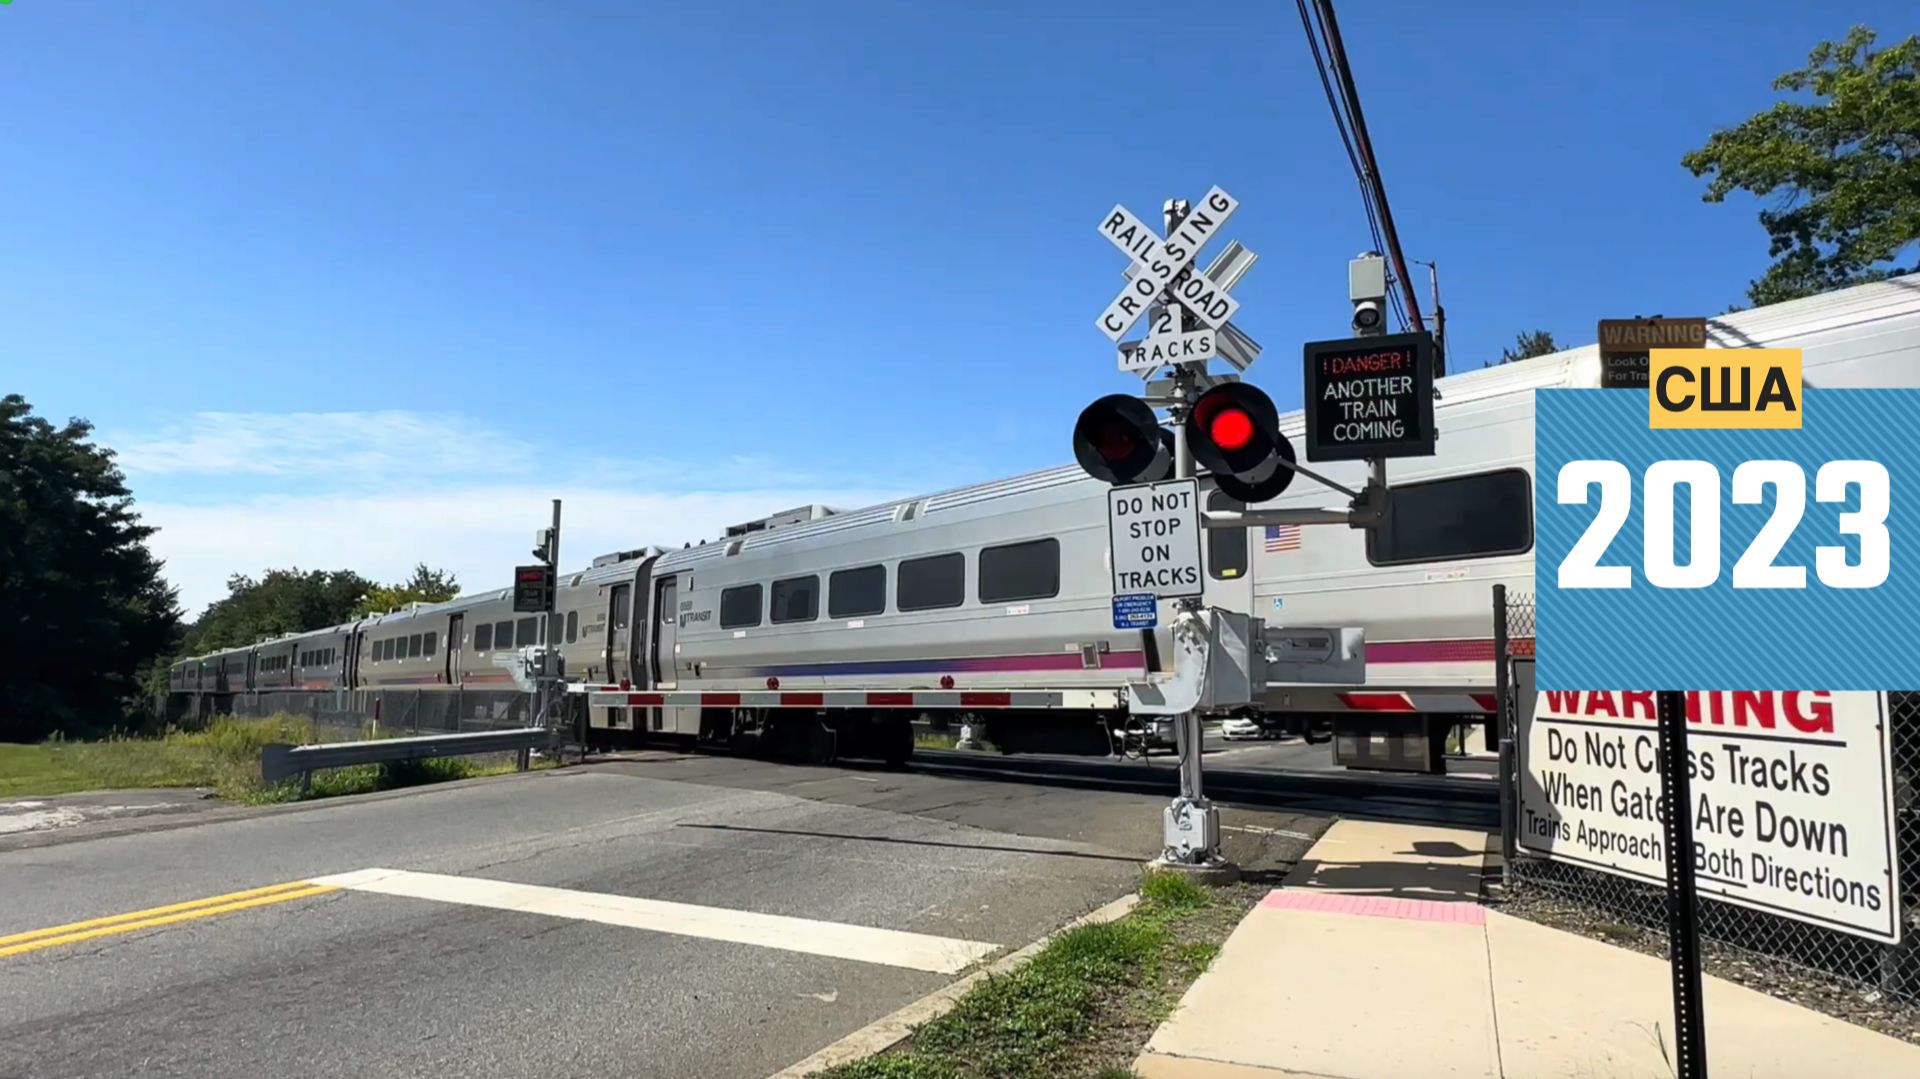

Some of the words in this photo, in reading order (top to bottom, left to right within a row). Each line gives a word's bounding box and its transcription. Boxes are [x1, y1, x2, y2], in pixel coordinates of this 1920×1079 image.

[1104, 193, 1230, 332] CROSSING
[1104, 211, 1155, 263] RAIL
[1170, 268, 1229, 320] ROAD
[1157, 312, 1172, 334] 2
[1603, 323, 1704, 345] WARNING
[1122, 336, 1211, 365] TRACKS
[1332, 352, 1401, 374] DANGER
[1607, 357, 1637, 367] Look
[1608, 371, 1627, 381] For
[1629, 371, 1648, 381] Tra
[1323, 376, 1413, 400] ANOTHER
[1339, 398, 1397, 420] TRAIN
[1333, 419, 1404, 441] COMING
[1117, 497, 1143, 516] DO
[1151, 491, 1190, 512] NOT
[1130, 518, 1181, 539] STOP
[1141, 544, 1170, 563] ON
[1118, 566, 1197, 589] TRACKS
[1548, 728, 1577, 763] Do
[1585, 731, 1627, 770] Not
[1635, 735, 1715, 781] Crss
[1722, 743, 1830, 796] Tracks
[1542, 769, 1602, 813] When
[1611, 779, 1665, 825] Gate
[1696, 793, 1744, 838] Are
[1755, 800, 1848, 857] Down
[1526, 809, 1571, 842] Trains
[1576, 819, 1662, 862] Approach
[1693, 841, 1743, 880] Both
[1751, 852, 1881, 911] Directions
